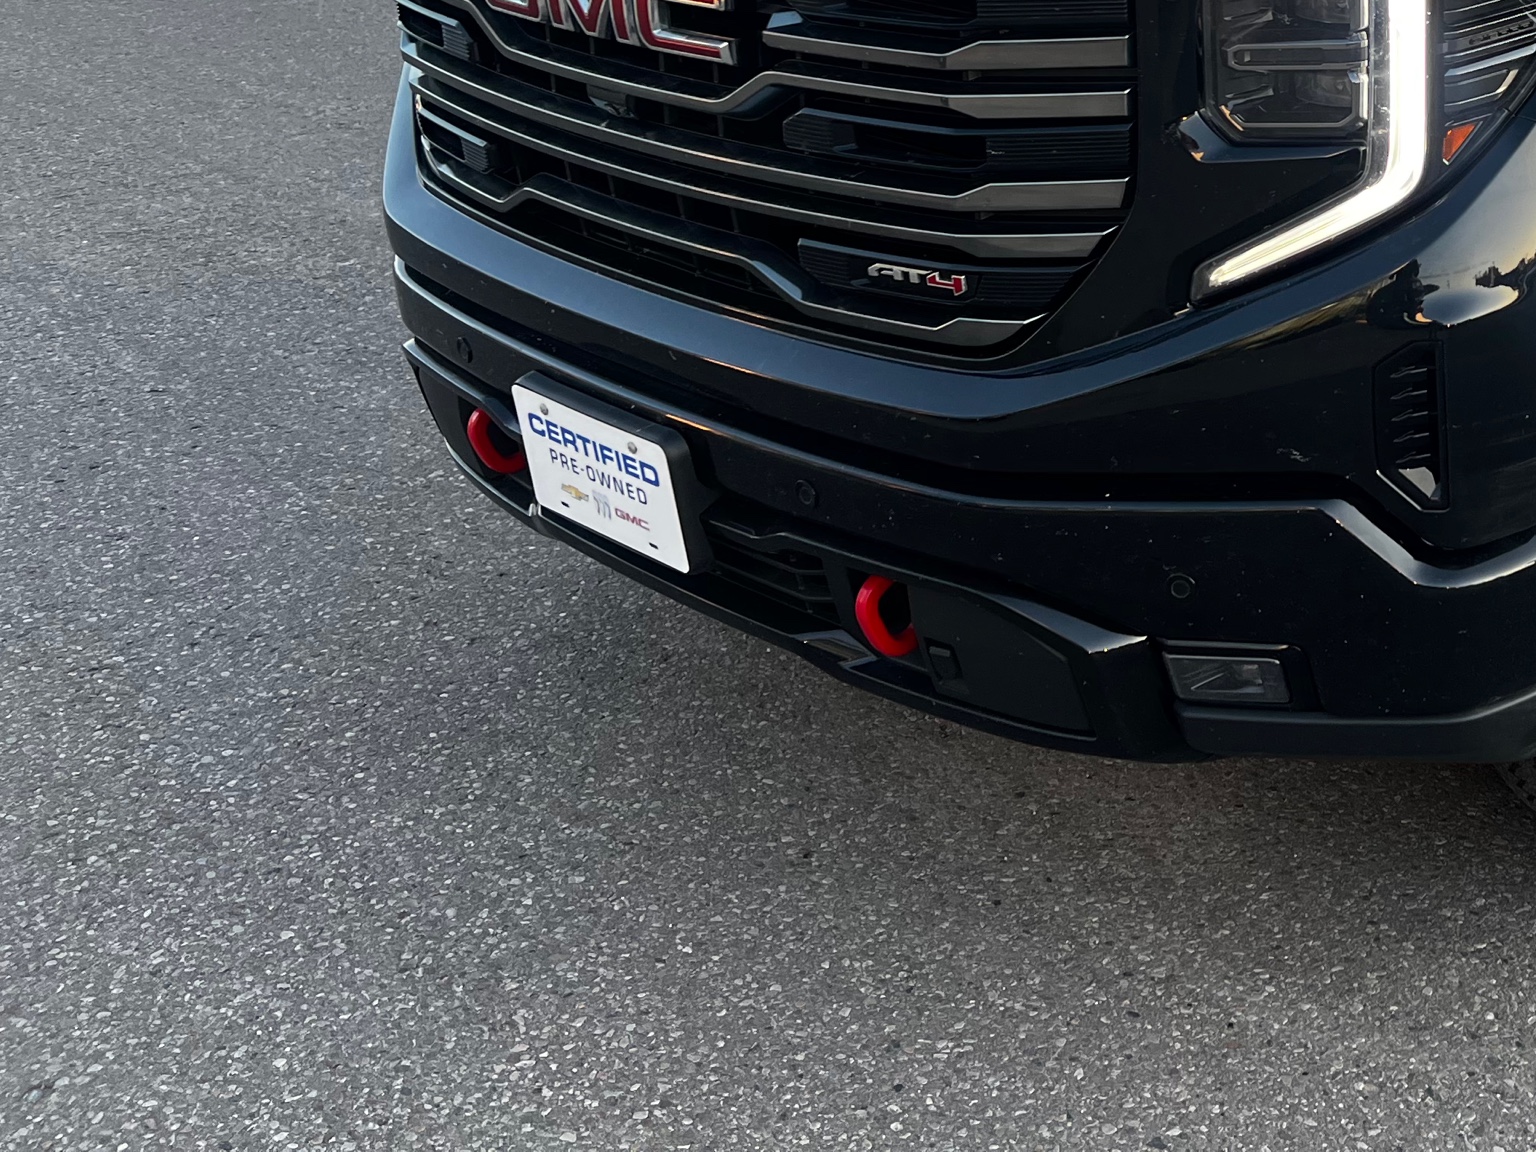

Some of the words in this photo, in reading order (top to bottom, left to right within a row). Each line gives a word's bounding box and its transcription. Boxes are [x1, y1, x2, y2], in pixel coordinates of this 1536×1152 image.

[866, 262, 969, 297] AT4
[527, 412, 660, 488] CERTIFIED
[548, 447, 648, 506] PRE-OWNED
[614, 507, 651, 532] GMC
